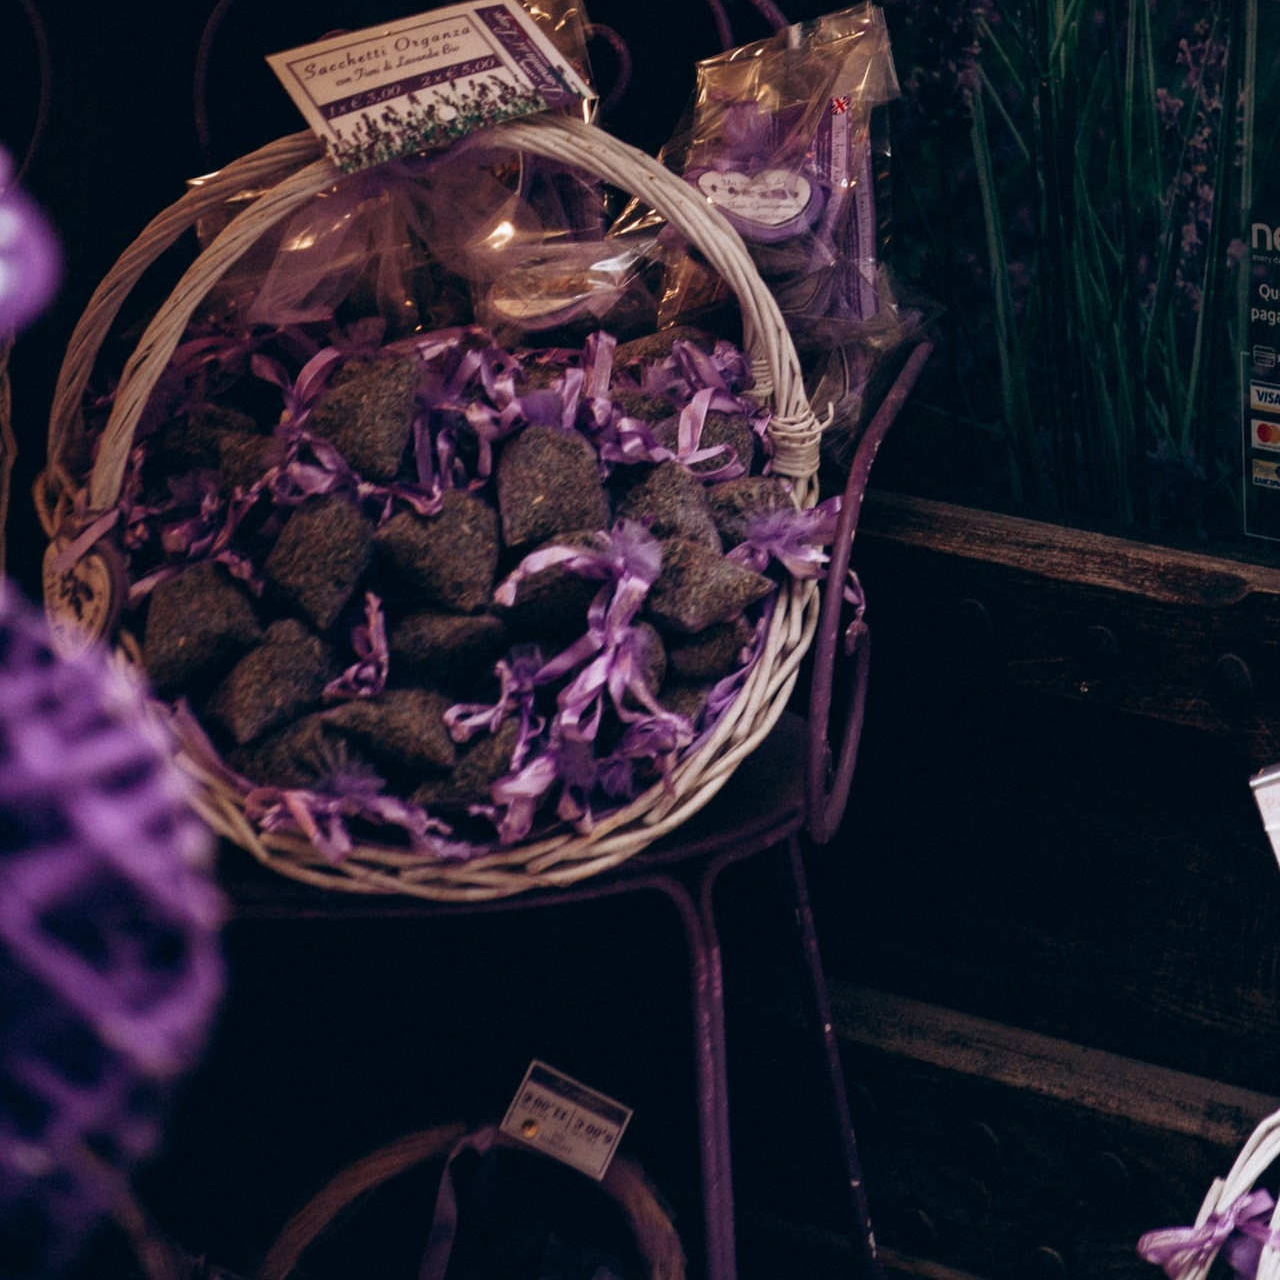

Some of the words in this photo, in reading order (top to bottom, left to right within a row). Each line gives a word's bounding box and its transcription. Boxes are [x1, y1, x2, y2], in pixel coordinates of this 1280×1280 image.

[304, 45, 388, 80] Sacchetti
[394, 25, 471, 51] Organza
[1252, 254, 1272, 265] every
